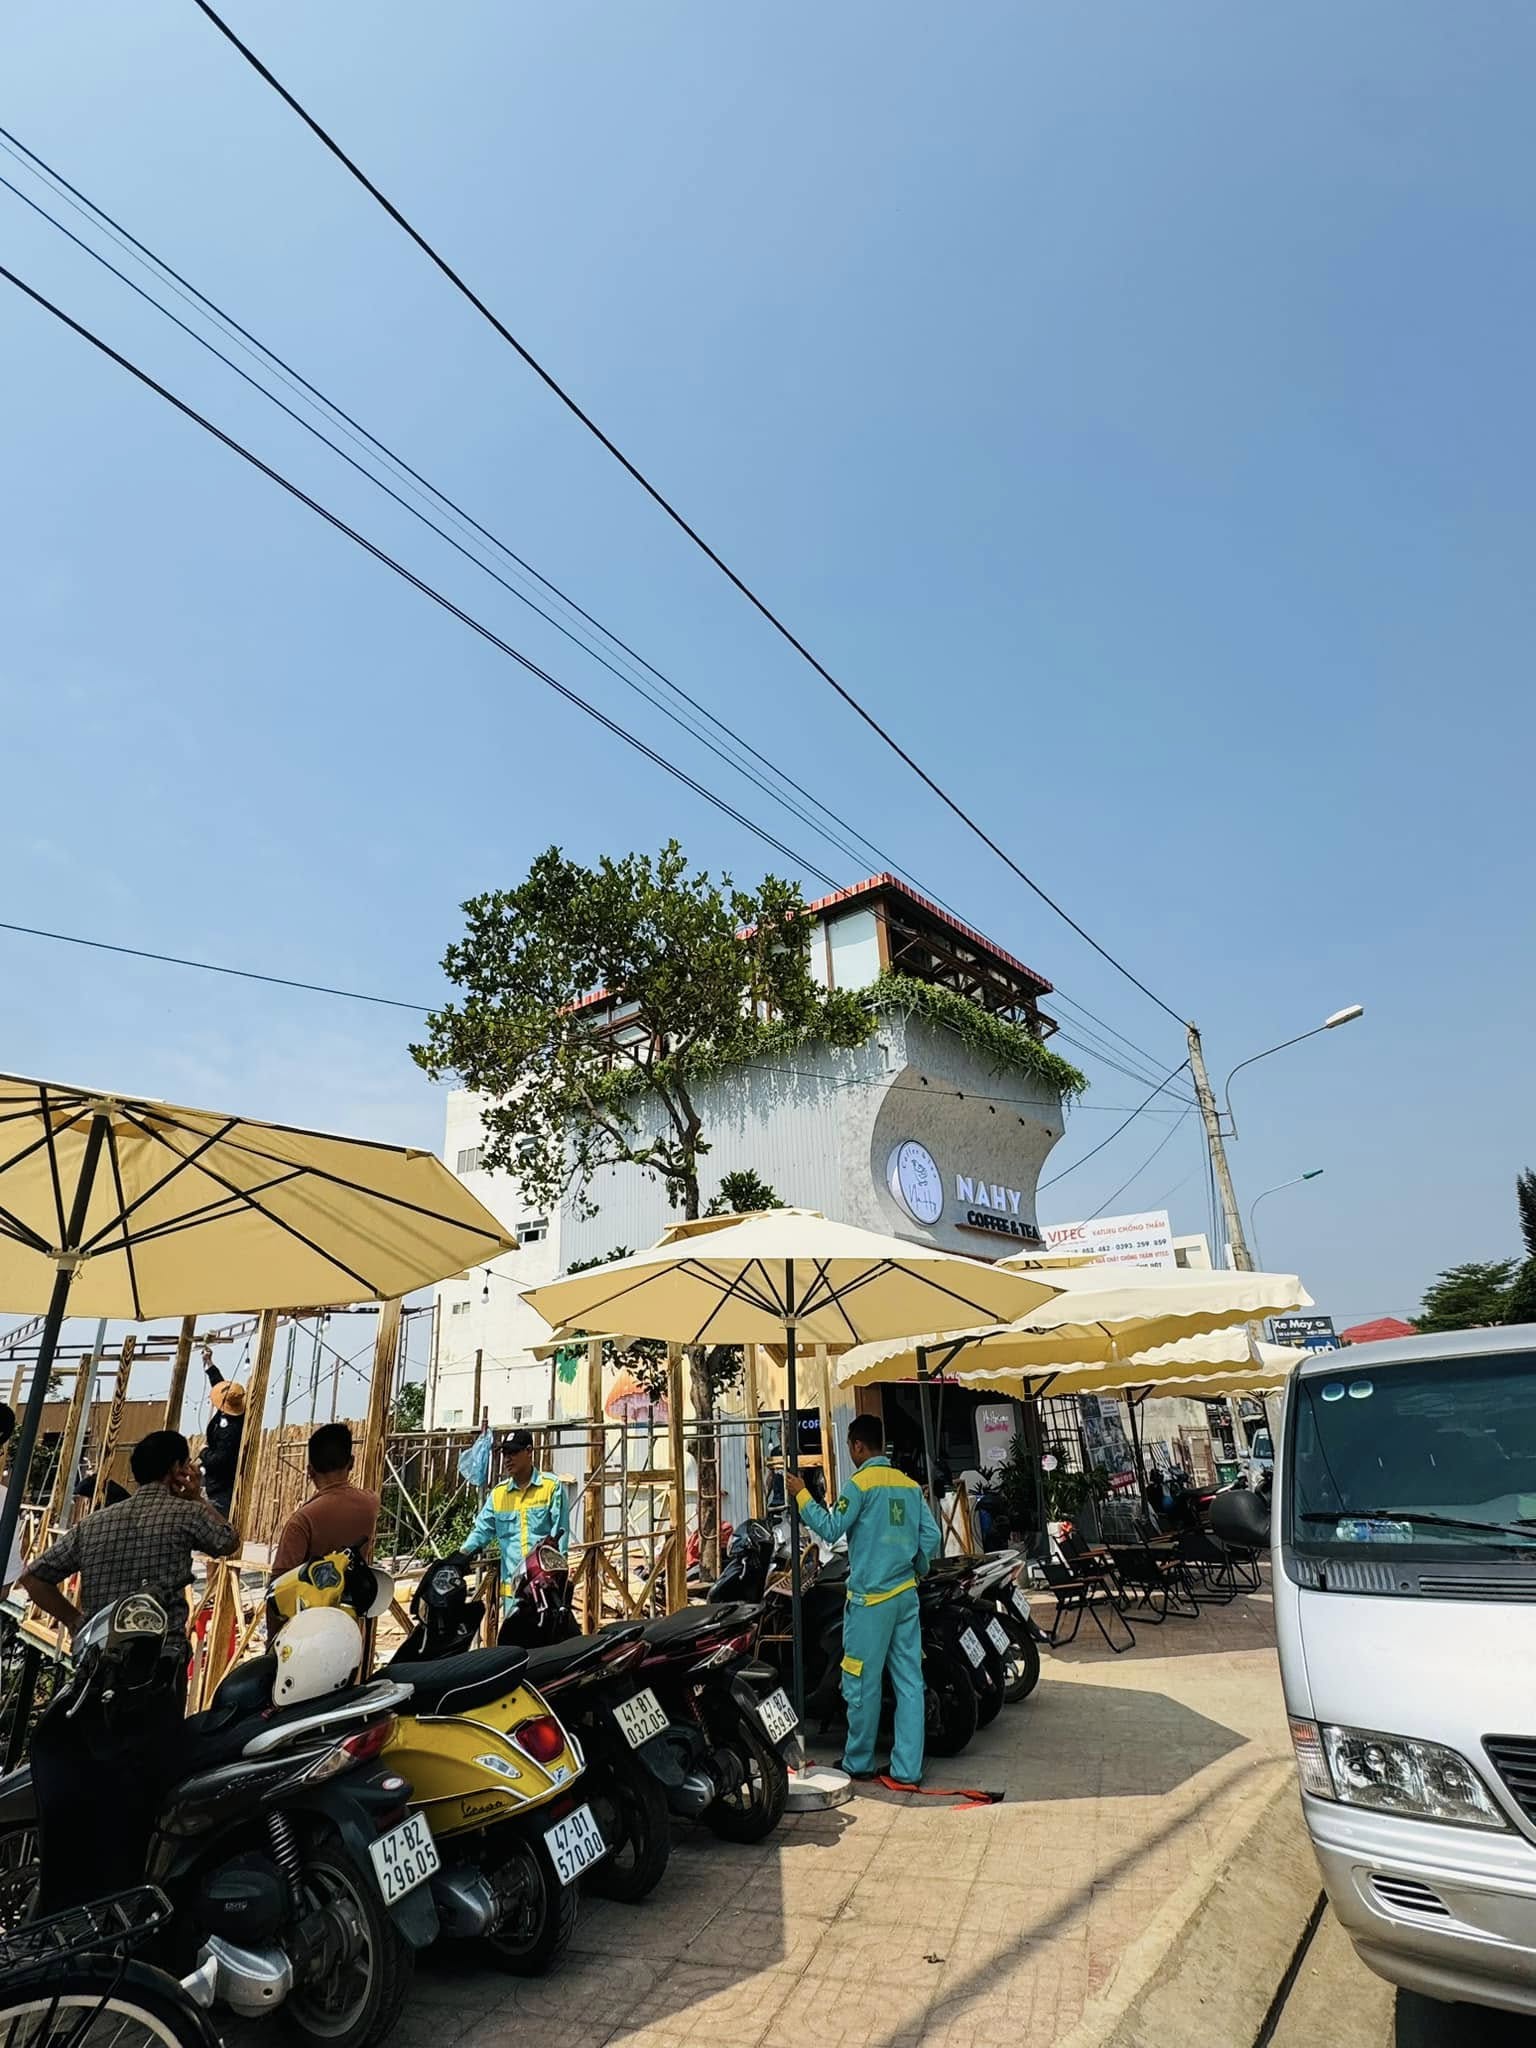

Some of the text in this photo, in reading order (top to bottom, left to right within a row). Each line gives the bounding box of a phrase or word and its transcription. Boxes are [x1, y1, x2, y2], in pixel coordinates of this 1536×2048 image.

[956, 1174, 1021, 1215] NAHY
[967, 1210, 1040, 1240] COFFEE & TEA
[1047, 1227, 1086, 1243] VITEC
[1273, 1320, 1287, 1329] Xe
[1289, 1319, 1313, 1330] Máy
[621, 1694, 653, 1722] 47-B1
[627, 1708, 666, 1744] 032.05
[768, 1707, 797, 1740] 659.90
[382, 1821, 424, 1864] 47-B2
[554, 1811, 589, 1850] 47-D1
[383, 1842, 437, 1899] 296.05
[557, 1831, 603, 1879] 570.00
